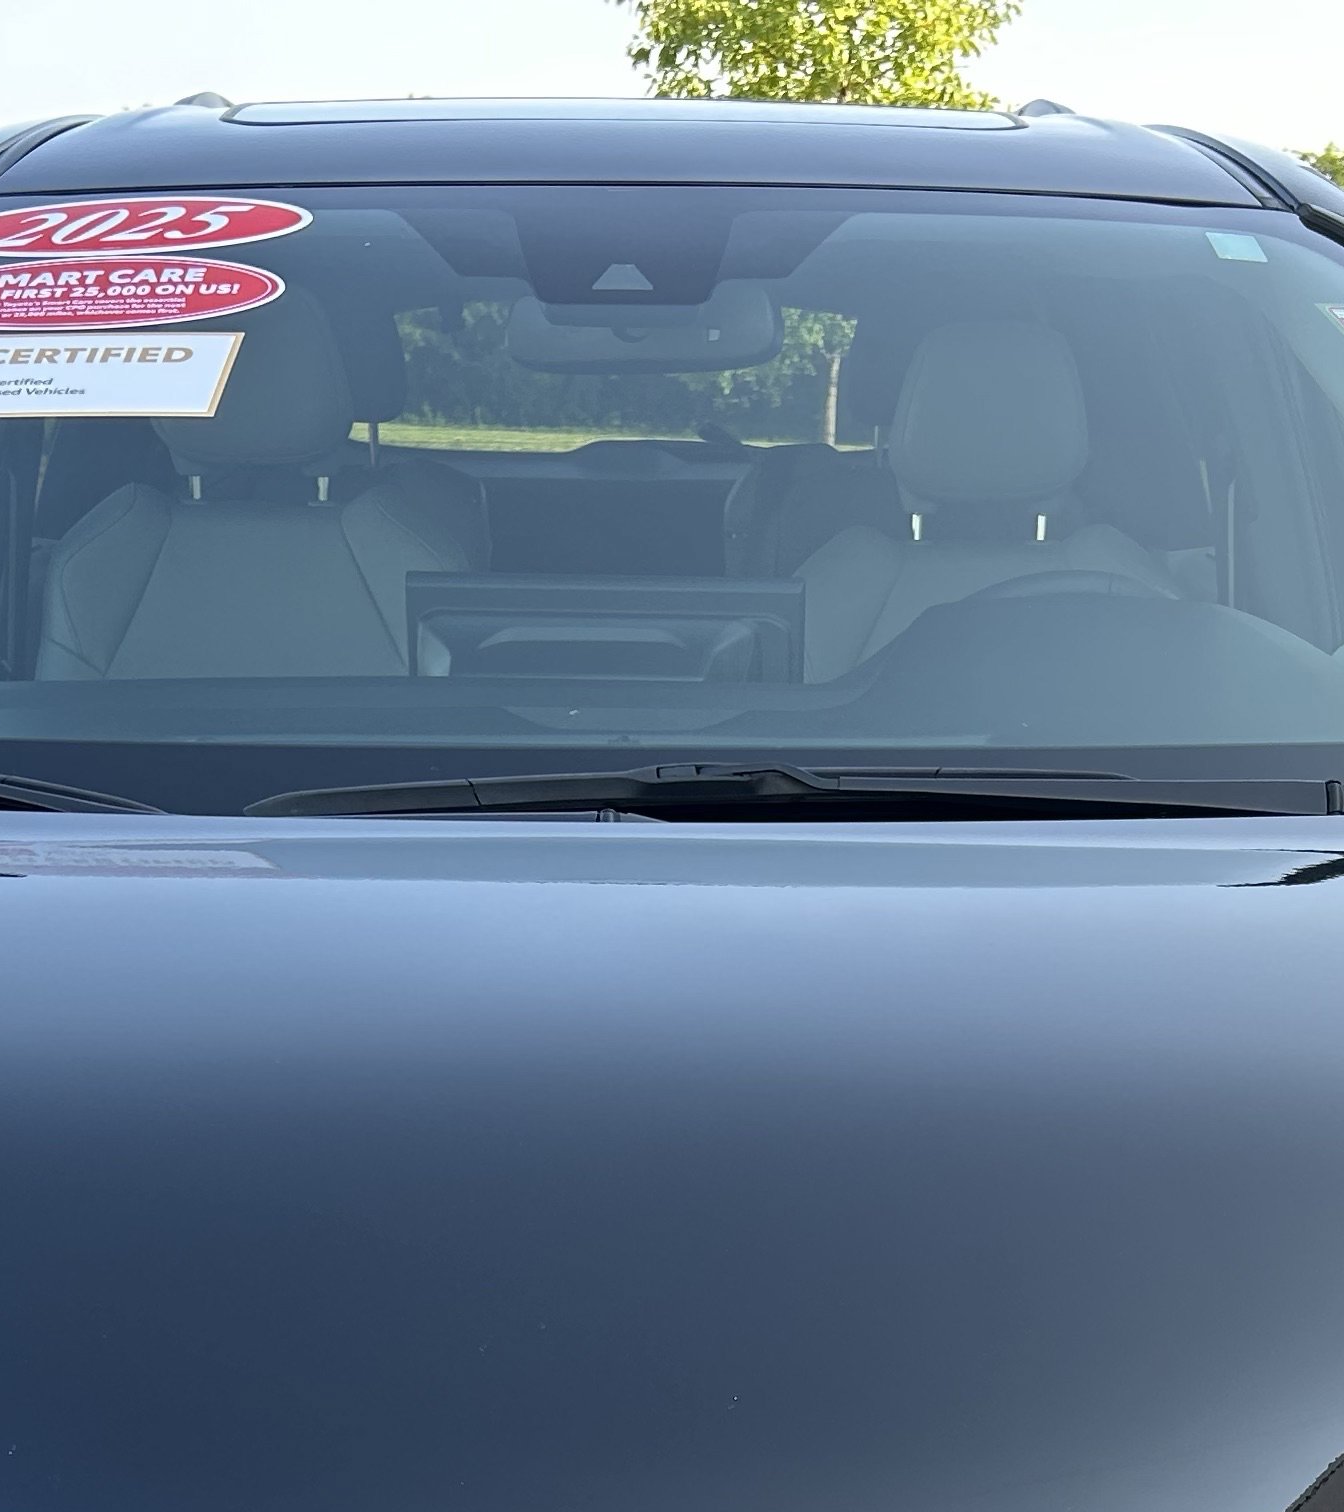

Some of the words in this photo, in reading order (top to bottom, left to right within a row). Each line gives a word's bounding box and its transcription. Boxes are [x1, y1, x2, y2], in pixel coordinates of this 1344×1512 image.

[109, 267, 207, 284] CARE
[0, 288, 68, 300] FIRST
[69, 285, 151, 299] 25,000
[155, 284, 195, 296] ON
[199, 283, 240, 295] US!
[26, 387, 85, 396] Vehicles
